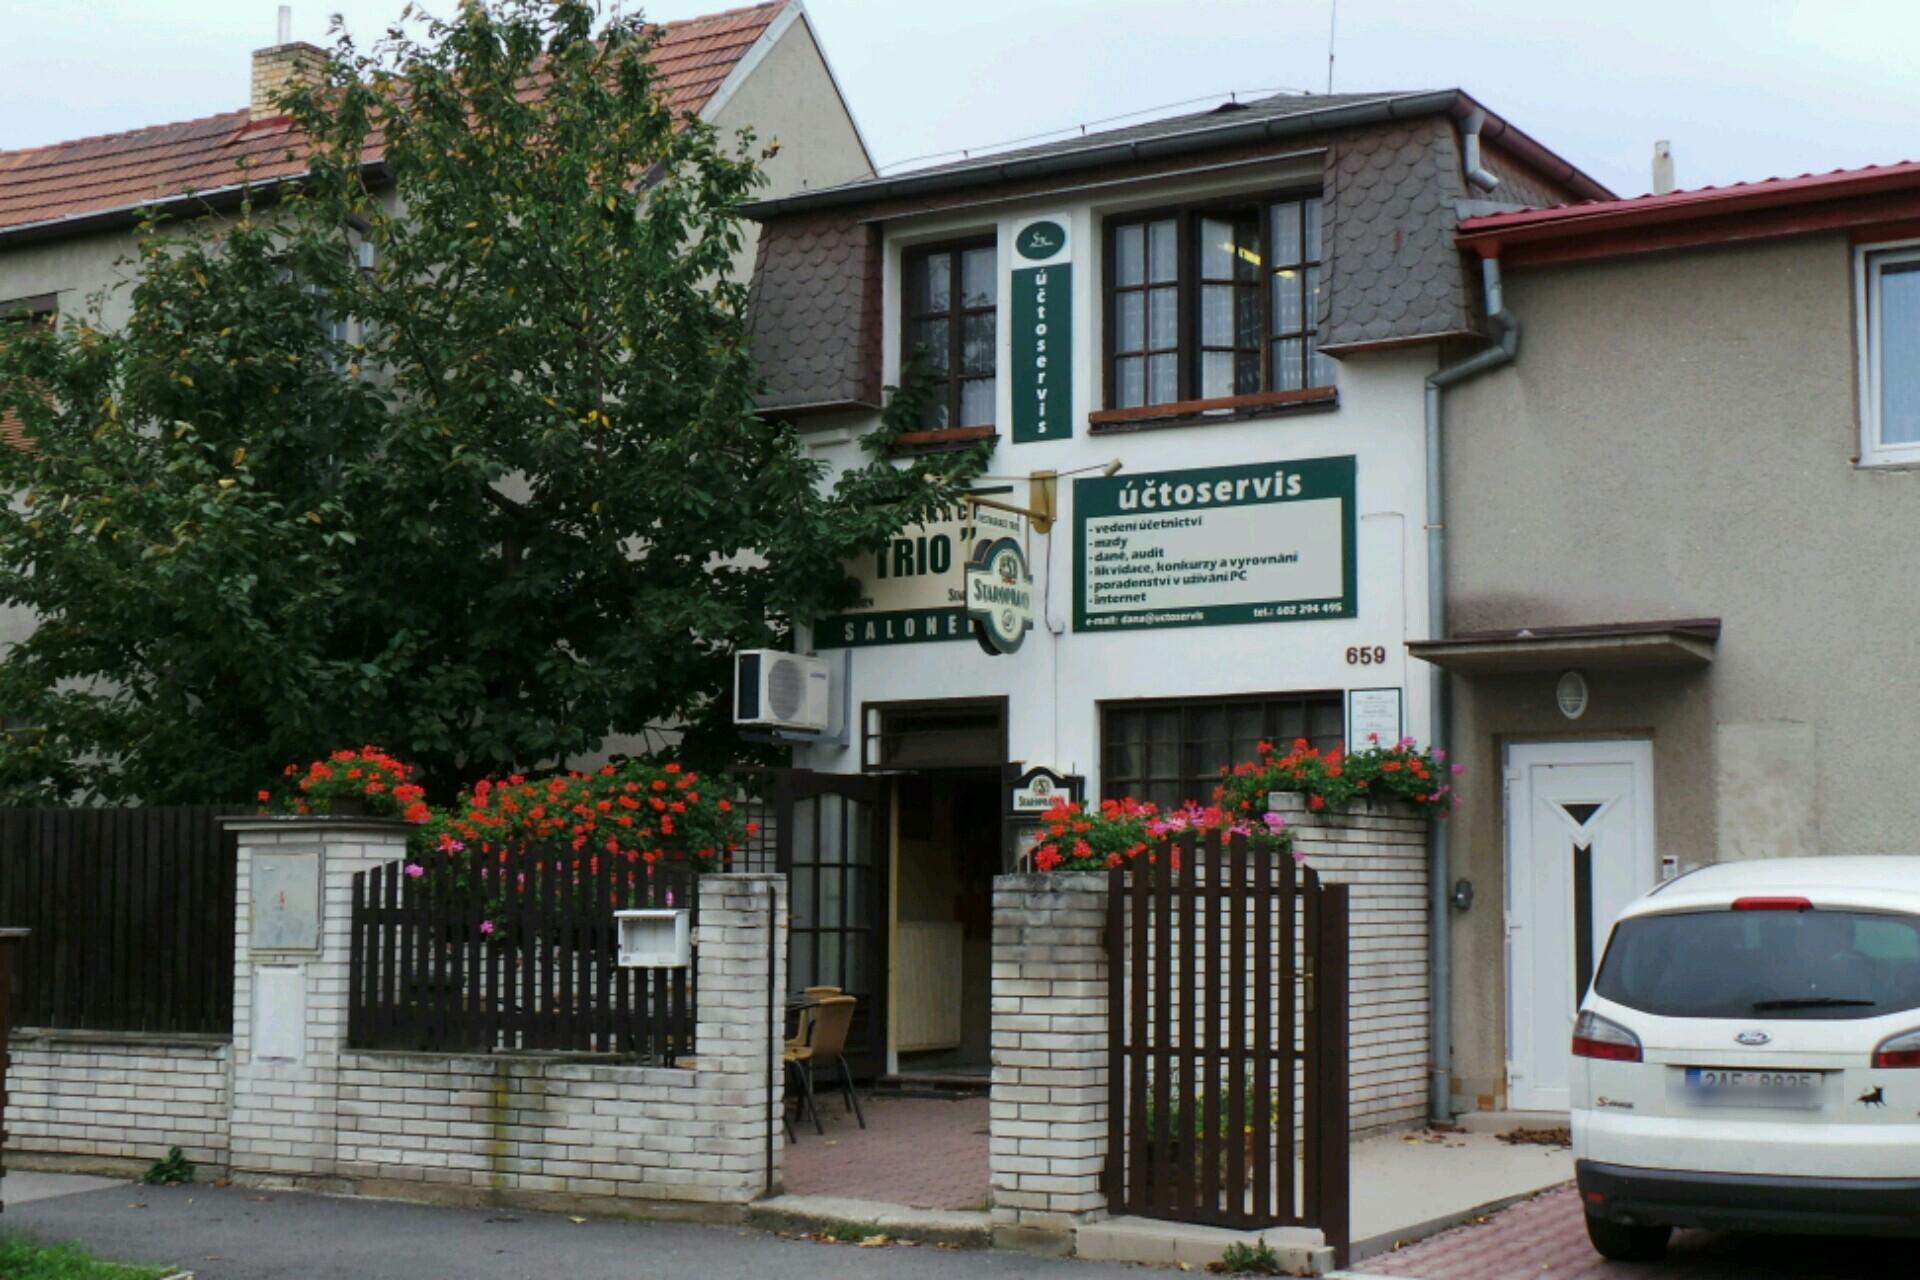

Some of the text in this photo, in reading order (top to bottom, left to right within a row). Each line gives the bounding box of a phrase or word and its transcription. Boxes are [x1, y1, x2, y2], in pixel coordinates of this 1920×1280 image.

[1035, 269, 1048, 434] účtoservis
[1118, 470, 1303, 511] účtoservis
[1094, 537, 1128, 550] mzdy
[1131, 547, 1165, 560] audit
[1156, 559, 1217, 573] konkurzy
[1230, 570, 1247, 582] PC
[1094, 592, 1147, 605] internet
[1346, 646, 1386, 665] 659
